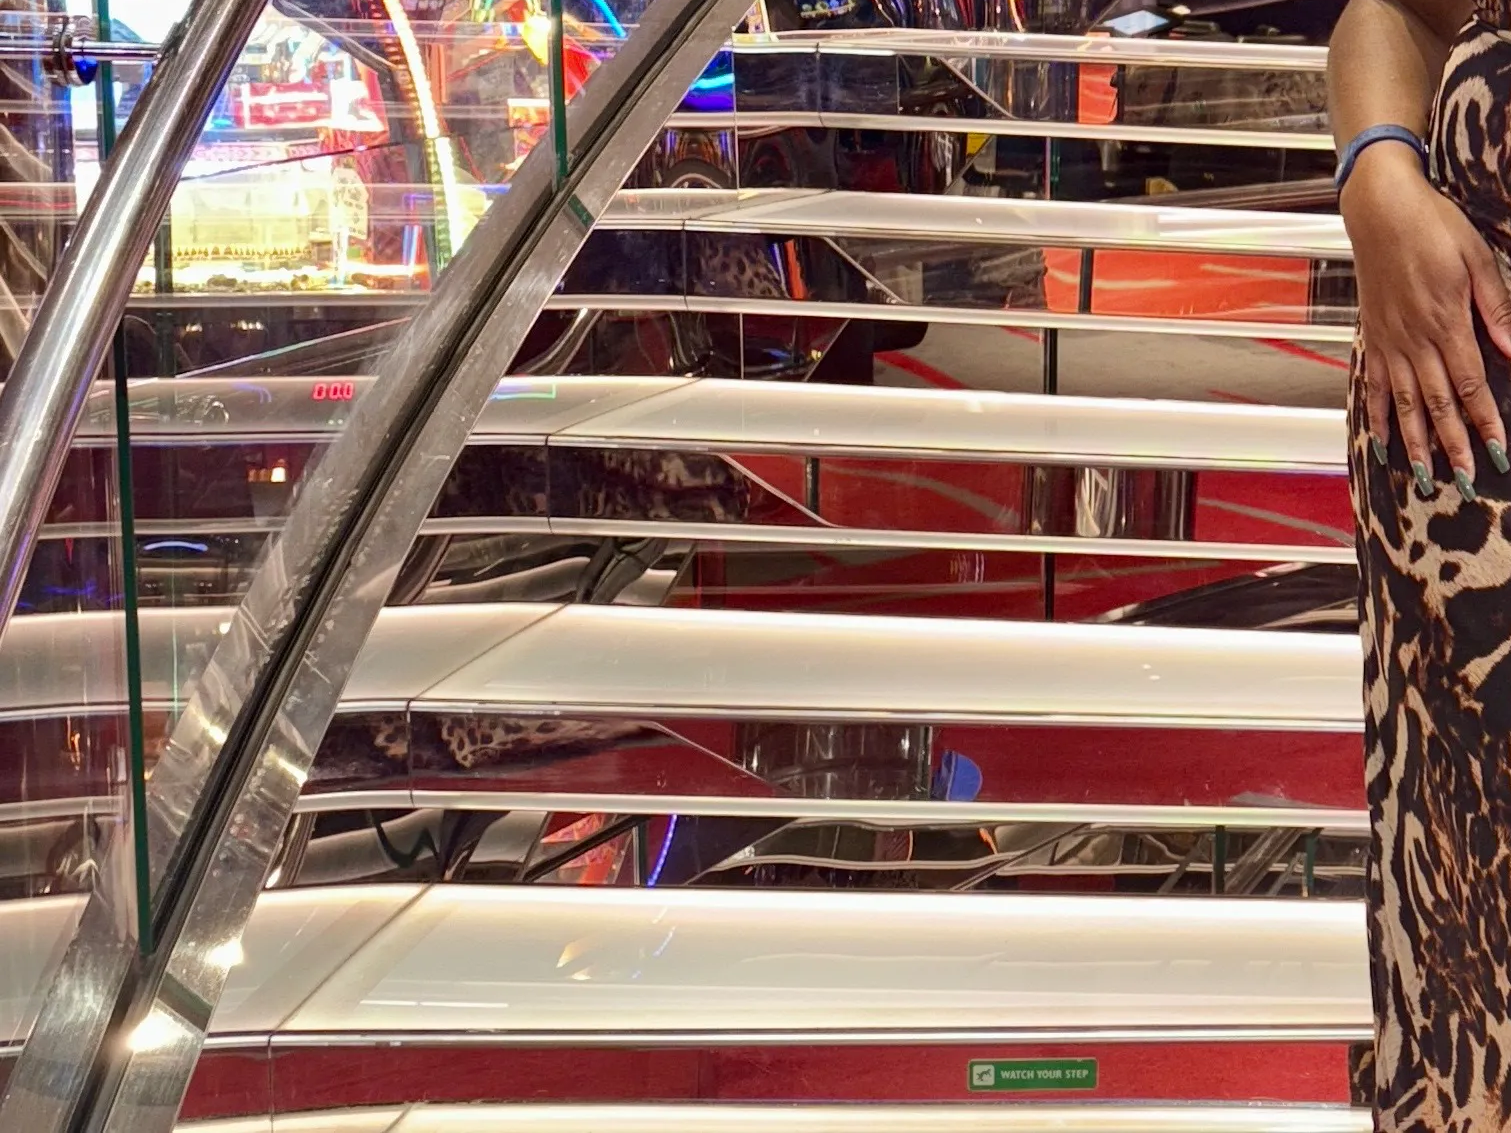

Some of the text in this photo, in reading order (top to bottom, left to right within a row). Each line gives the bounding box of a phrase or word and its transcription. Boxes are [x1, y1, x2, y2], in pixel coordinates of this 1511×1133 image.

[1000, 1069, 1089, 1080] WATCH YOUR STEP
